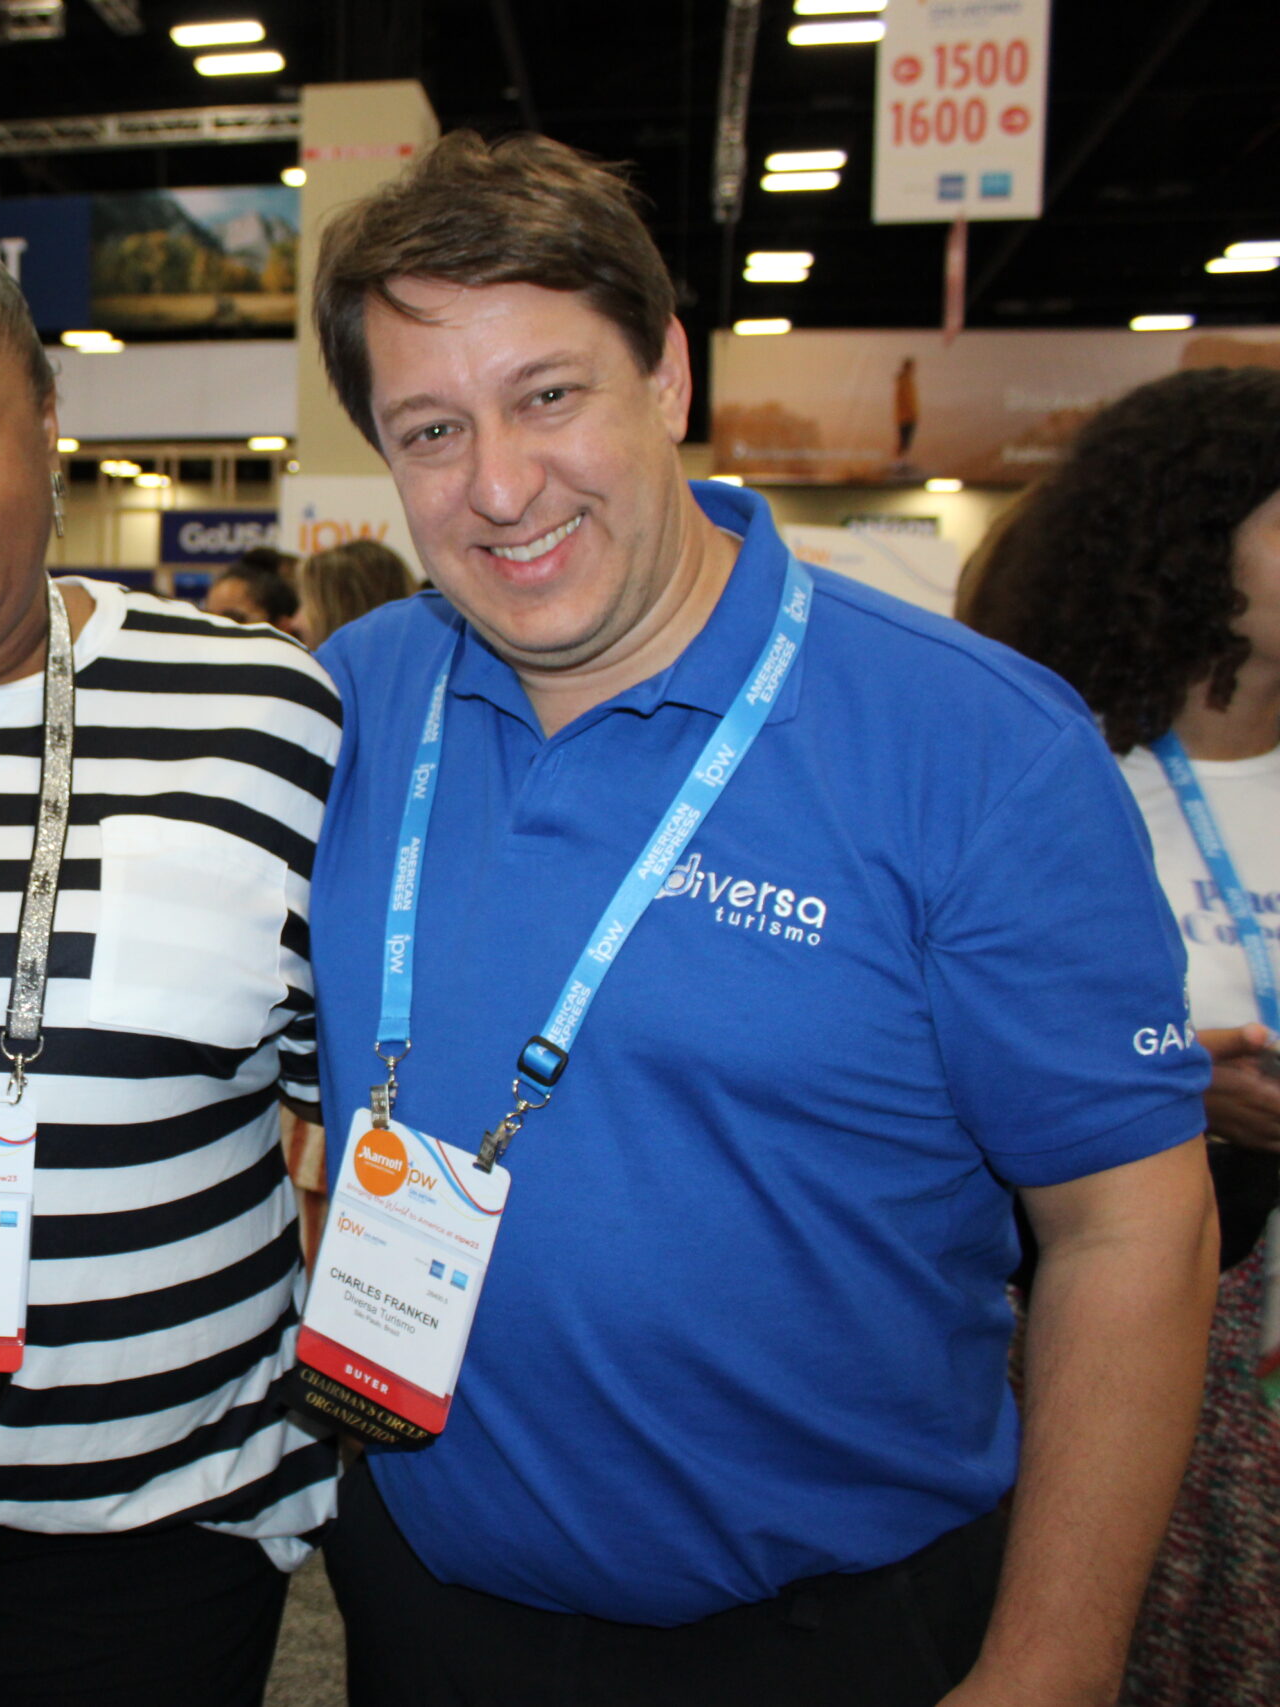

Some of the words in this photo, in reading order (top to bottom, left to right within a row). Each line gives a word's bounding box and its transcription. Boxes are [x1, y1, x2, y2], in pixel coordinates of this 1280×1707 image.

[933, 38, 1029, 89] 1500
[891, 96, 987, 147] 1600
[746, 633, 788, 706] AMERICAN
[761, 640, 796, 703] EXPRESS
[413, 763, 436, 799] ipw
[696, 744, 736, 788] ipw
[637, 802, 691, 880] AMERICAN
[652, 808, 701, 876] EXPRESS
[392, 845, 410, 912] EXPRESS
[403, 836, 421, 911] AMERICAN
[654, 853, 827, 929] diversa
[588, 920, 626, 963] ipw
[715, 906, 821, 946] turismo
[387, 933, 411, 975] ipw
[558, 985, 592, 1048] XPRESS
[358, 1146, 403, 1172] Marriott
[407, 1160, 437, 1190] pw
[337, 1211, 365, 1237] ipw
[330, 1267, 381, 1300] CHARLES
[384, 1294, 439, 1329] FRANKEN
[344, 1290, 378, 1314] Diversa
[380, 1307, 415, 1334] Turismo
[345, 1364, 389, 1394] BUYER
[377, 1411, 428, 1439] CIRCLE
